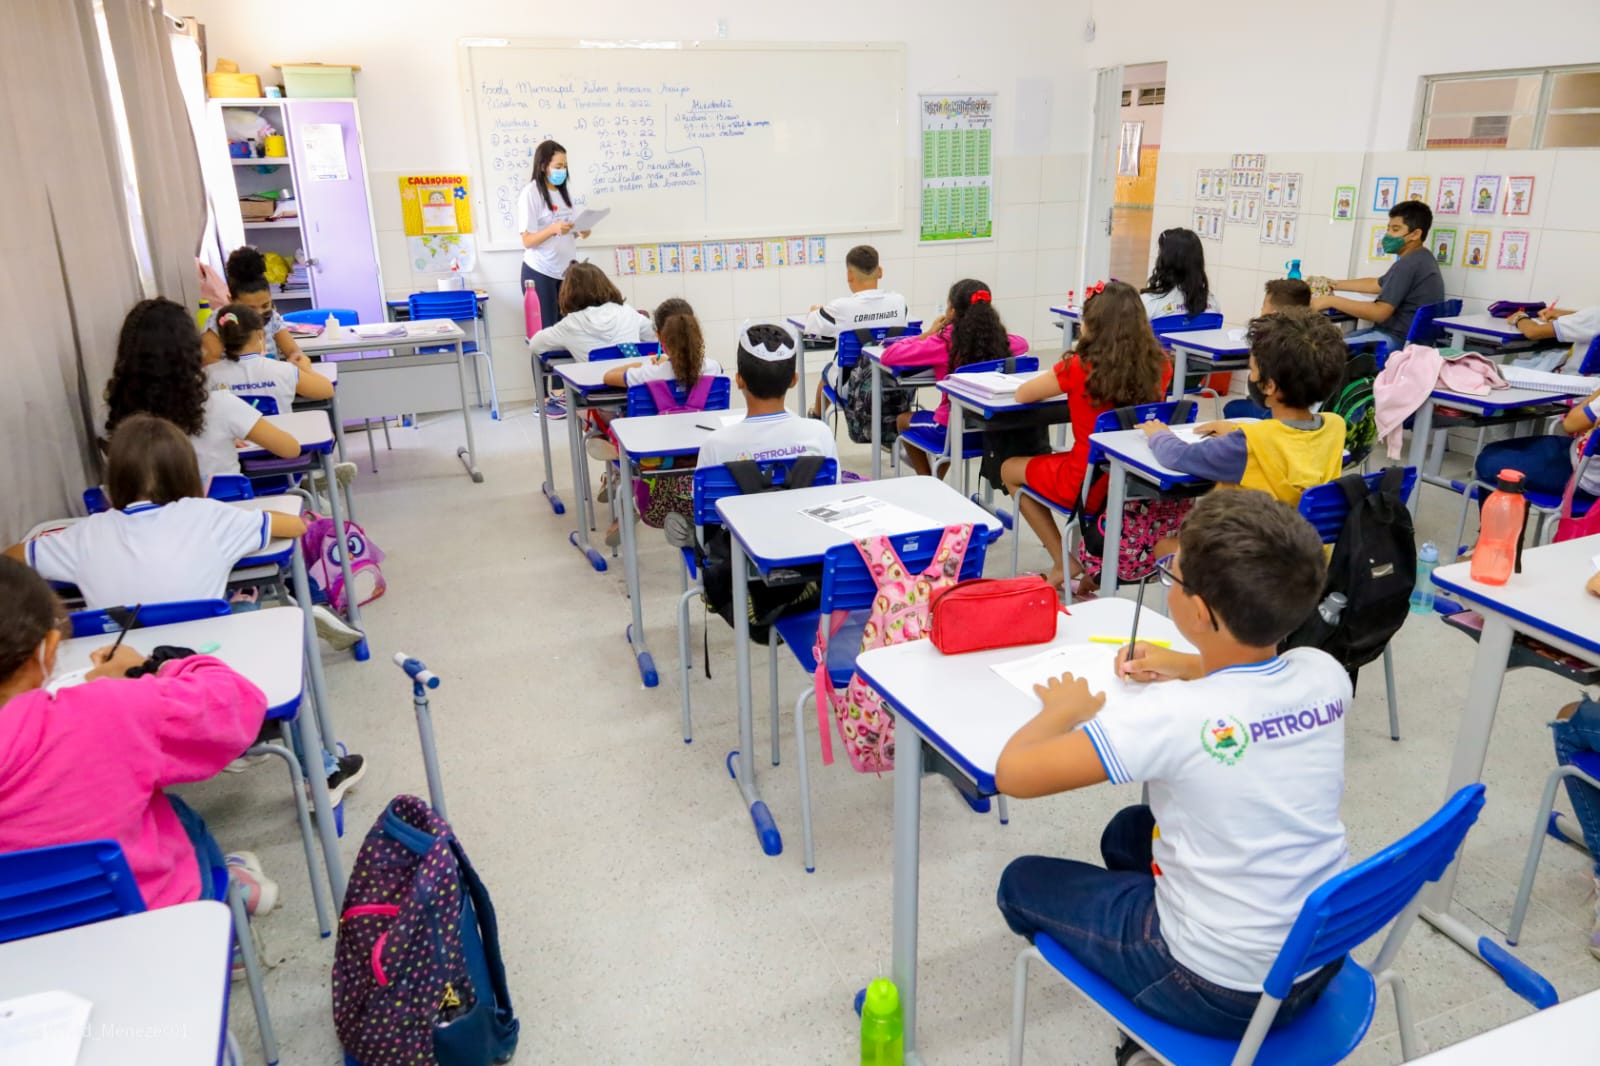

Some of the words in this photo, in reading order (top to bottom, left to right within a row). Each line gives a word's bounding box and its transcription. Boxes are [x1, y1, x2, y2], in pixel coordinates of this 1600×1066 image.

[516, 80, 576, 96] Municipal
[615, 115, 629, 126] 25
[231, 381, 276, 391] PETROLINA
[753, 445, 807, 460] PETROLINA
[1249, 698, 1344, 743] PETROLIN
